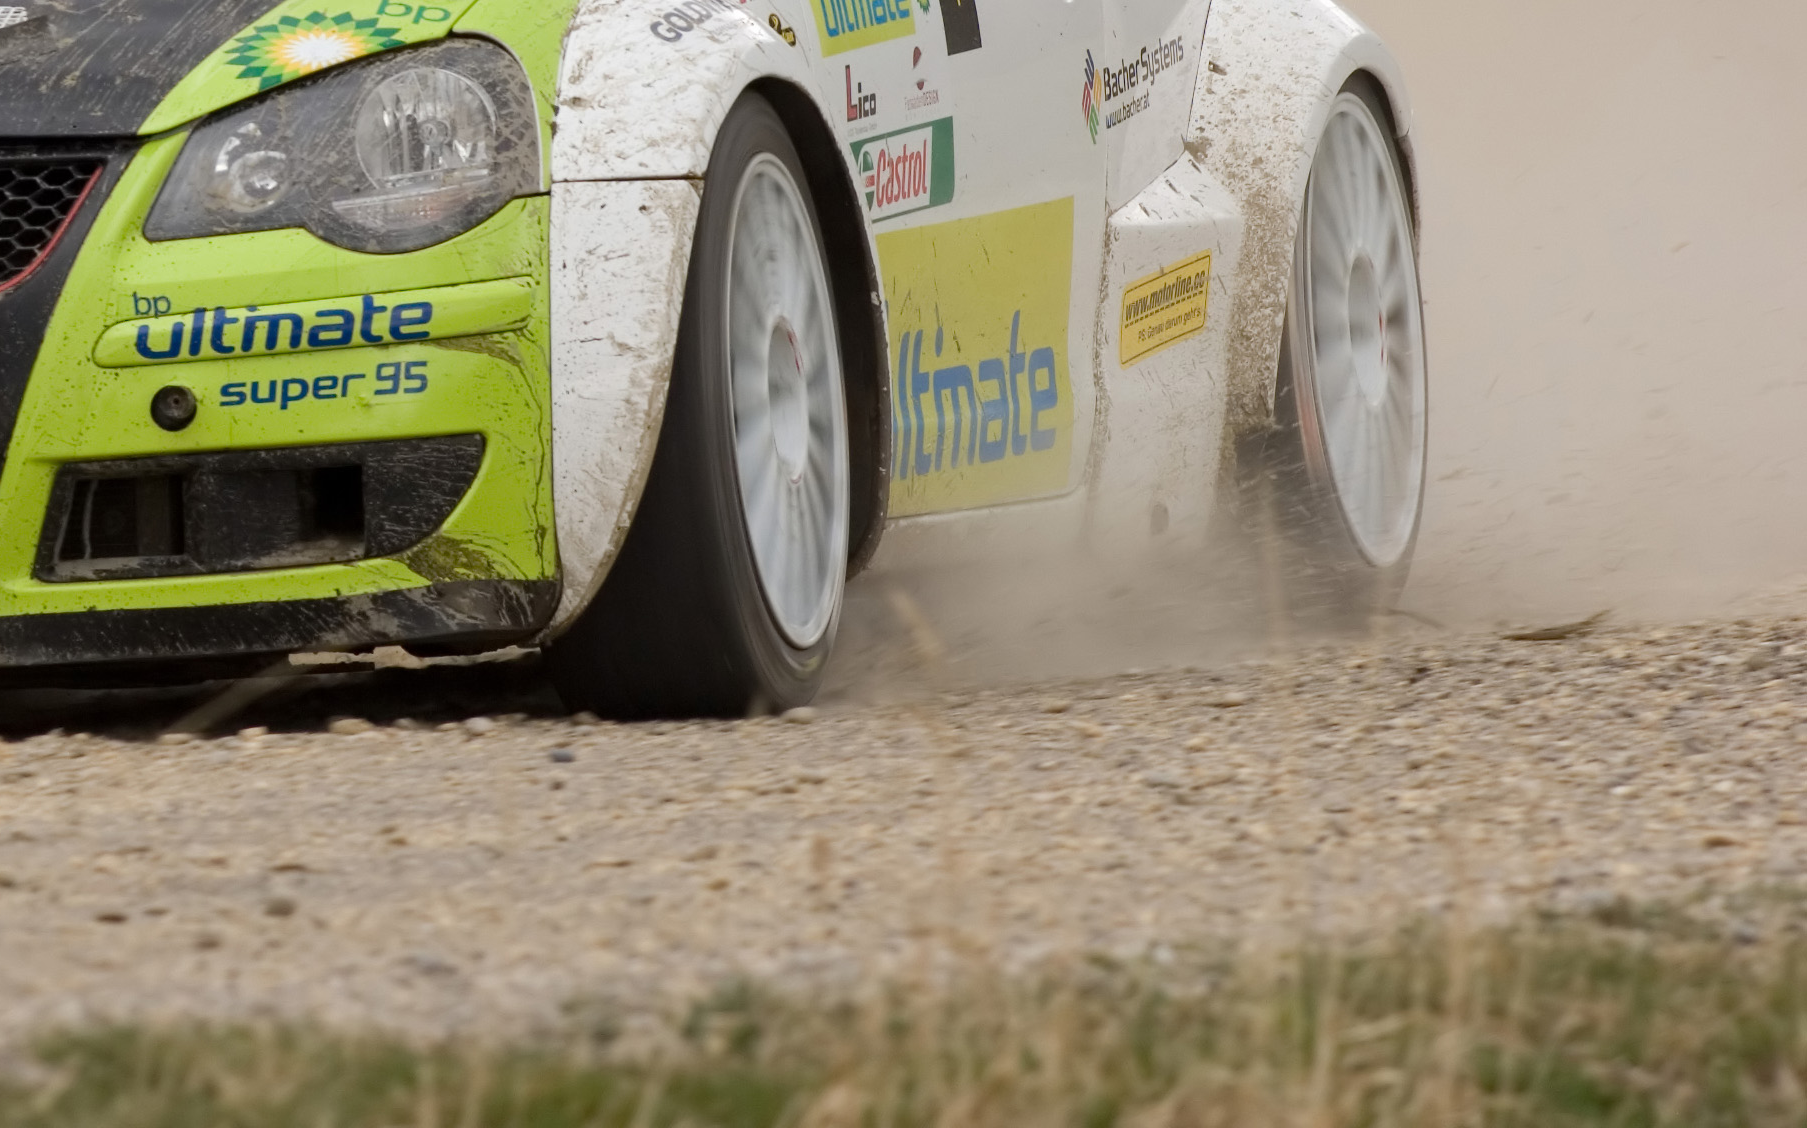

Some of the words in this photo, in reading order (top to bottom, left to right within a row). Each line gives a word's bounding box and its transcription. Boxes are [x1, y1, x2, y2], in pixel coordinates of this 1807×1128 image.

[845, 64, 876, 122] Lico
[875, 139, 928, 208] Castrol
[132, 292, 171, 318] bp
[135, 294, 433, 360] ultimate
[219, 373, 365, 410] super
[374, 361, 428, 395] 95
[891, 309, 1058, 481] ltimate
